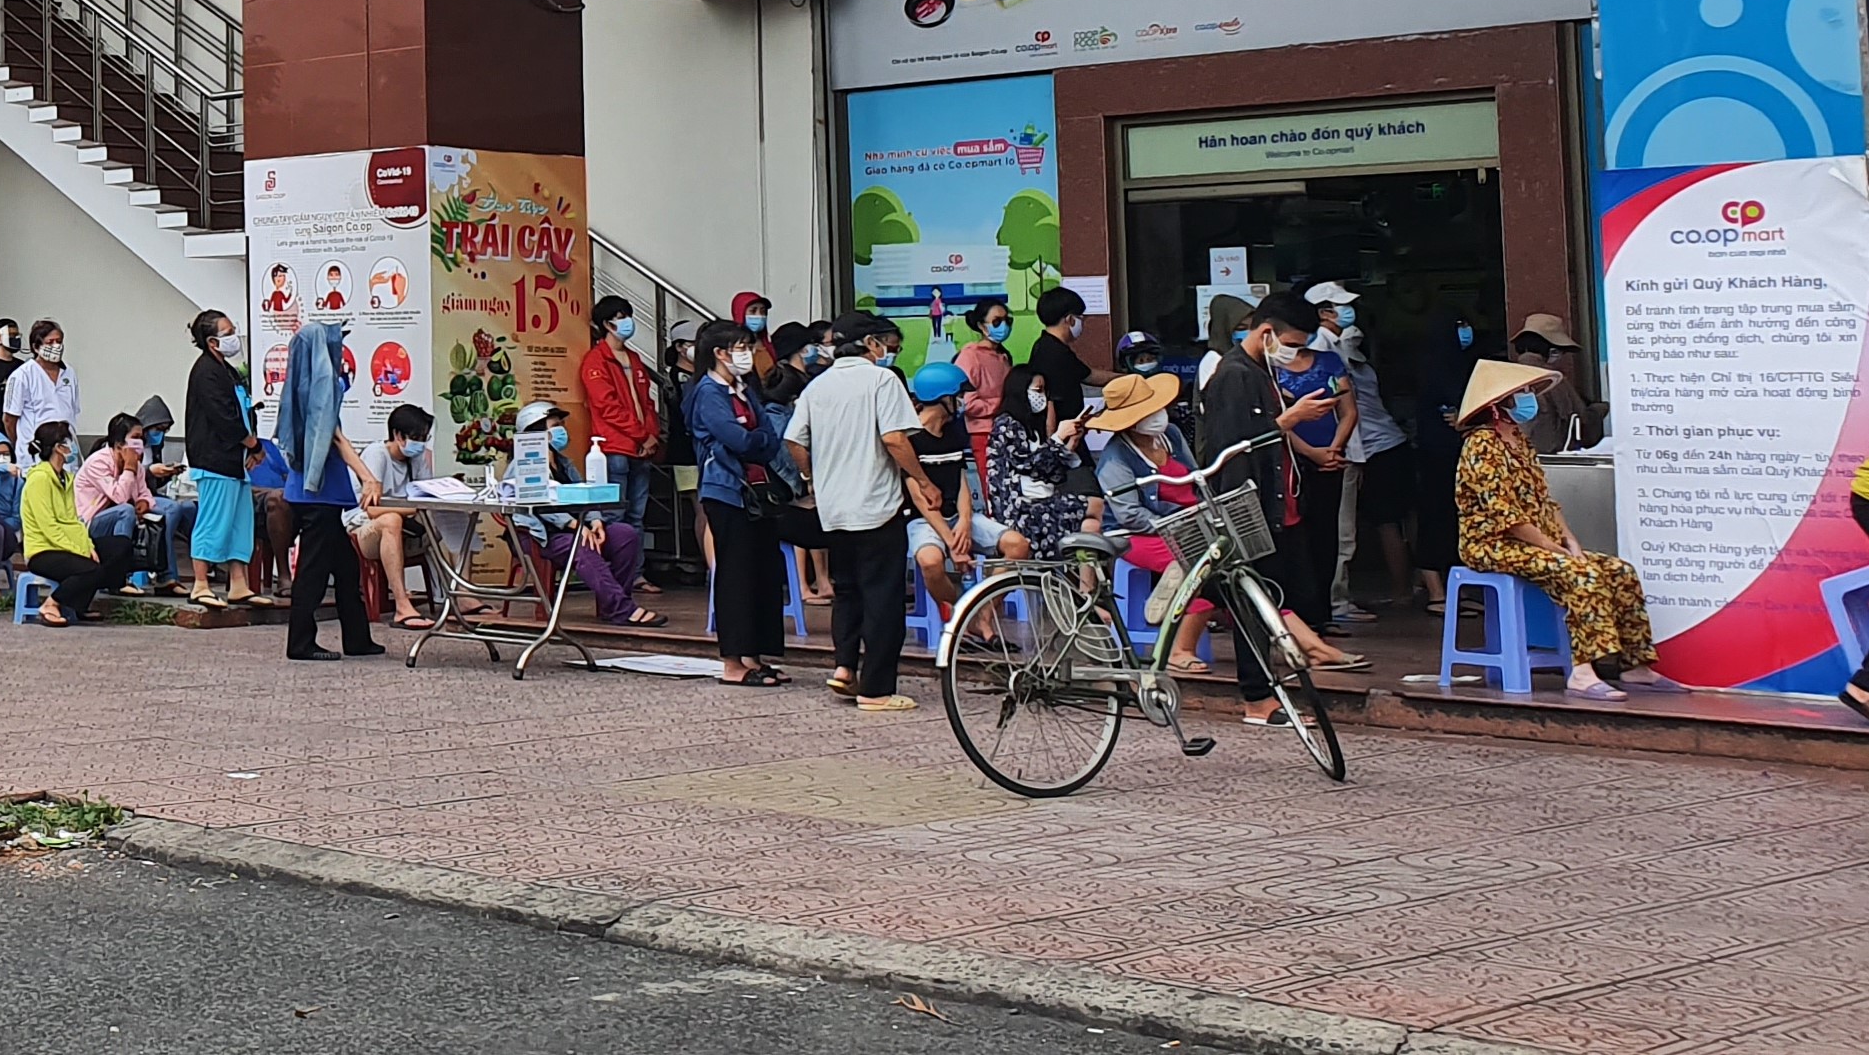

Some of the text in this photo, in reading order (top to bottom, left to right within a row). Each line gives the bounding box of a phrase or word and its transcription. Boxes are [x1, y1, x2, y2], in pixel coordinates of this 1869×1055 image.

[1199, 121, 1425, 149] Hân hoan chào đón quý khách
[957, 145, 980, 154] mua
[983, 139, 1005, 152] sắm
[865, 166, 887, 175] Giao
[313, 223, 343, 235] Saigon
[440, 213, 576, 263] TRÁI CÂY
[1625, 280, 1659, 292] Kính
[1663, 277, 1688, 293] gửi
[1693, 277, 1723, 292] Quý
[1728, 276, 1777, 290] Khách
[480, 297, 511, 317] ngay
[1761, 303, 1792, 315] trung
[1797, 303, 1824, 313] mua
[1795, 315, 1819, 328] đến
[1772, 332, 1810, 344] chúng
[1630, 373, 1640, 383] 1.
[1644, 373, 1674, 384] Thực
[1681, 372, 1705, 384] hiện
[1711, 371, 1732, 383] Chỉ
[1645, 424, 1781, 439] Thời gian phục vụ:
[1655, 450, 1678, 462] 06g
[1708, 450, 1732, 460] 24h
[1636, 465, 1658, 474] nhu
[1684, 466, 1710, 475] mua
[1653, 488, 1692, 502] Chúng
[1696, 488, 1710, 499] tôi
[1758, 492, 1787, 503] cung
[1639, 504, 1668, 516] hàng
[1745, 506, 1767, 516] nhu
[1640, 518, 1713, 531] Khách Hàng
[1641, 541, 1666, 554] Quý
[1669, 543, 1706, 554] Khách
[1709, 543, 1741, 555] Hàng
[1643, 557, 1672, 569] trung
[1709, 559, 1745, 571] người
[1643, 571, 1660, 581] lan
[1691, 572, 1724, 584] bệnh.
